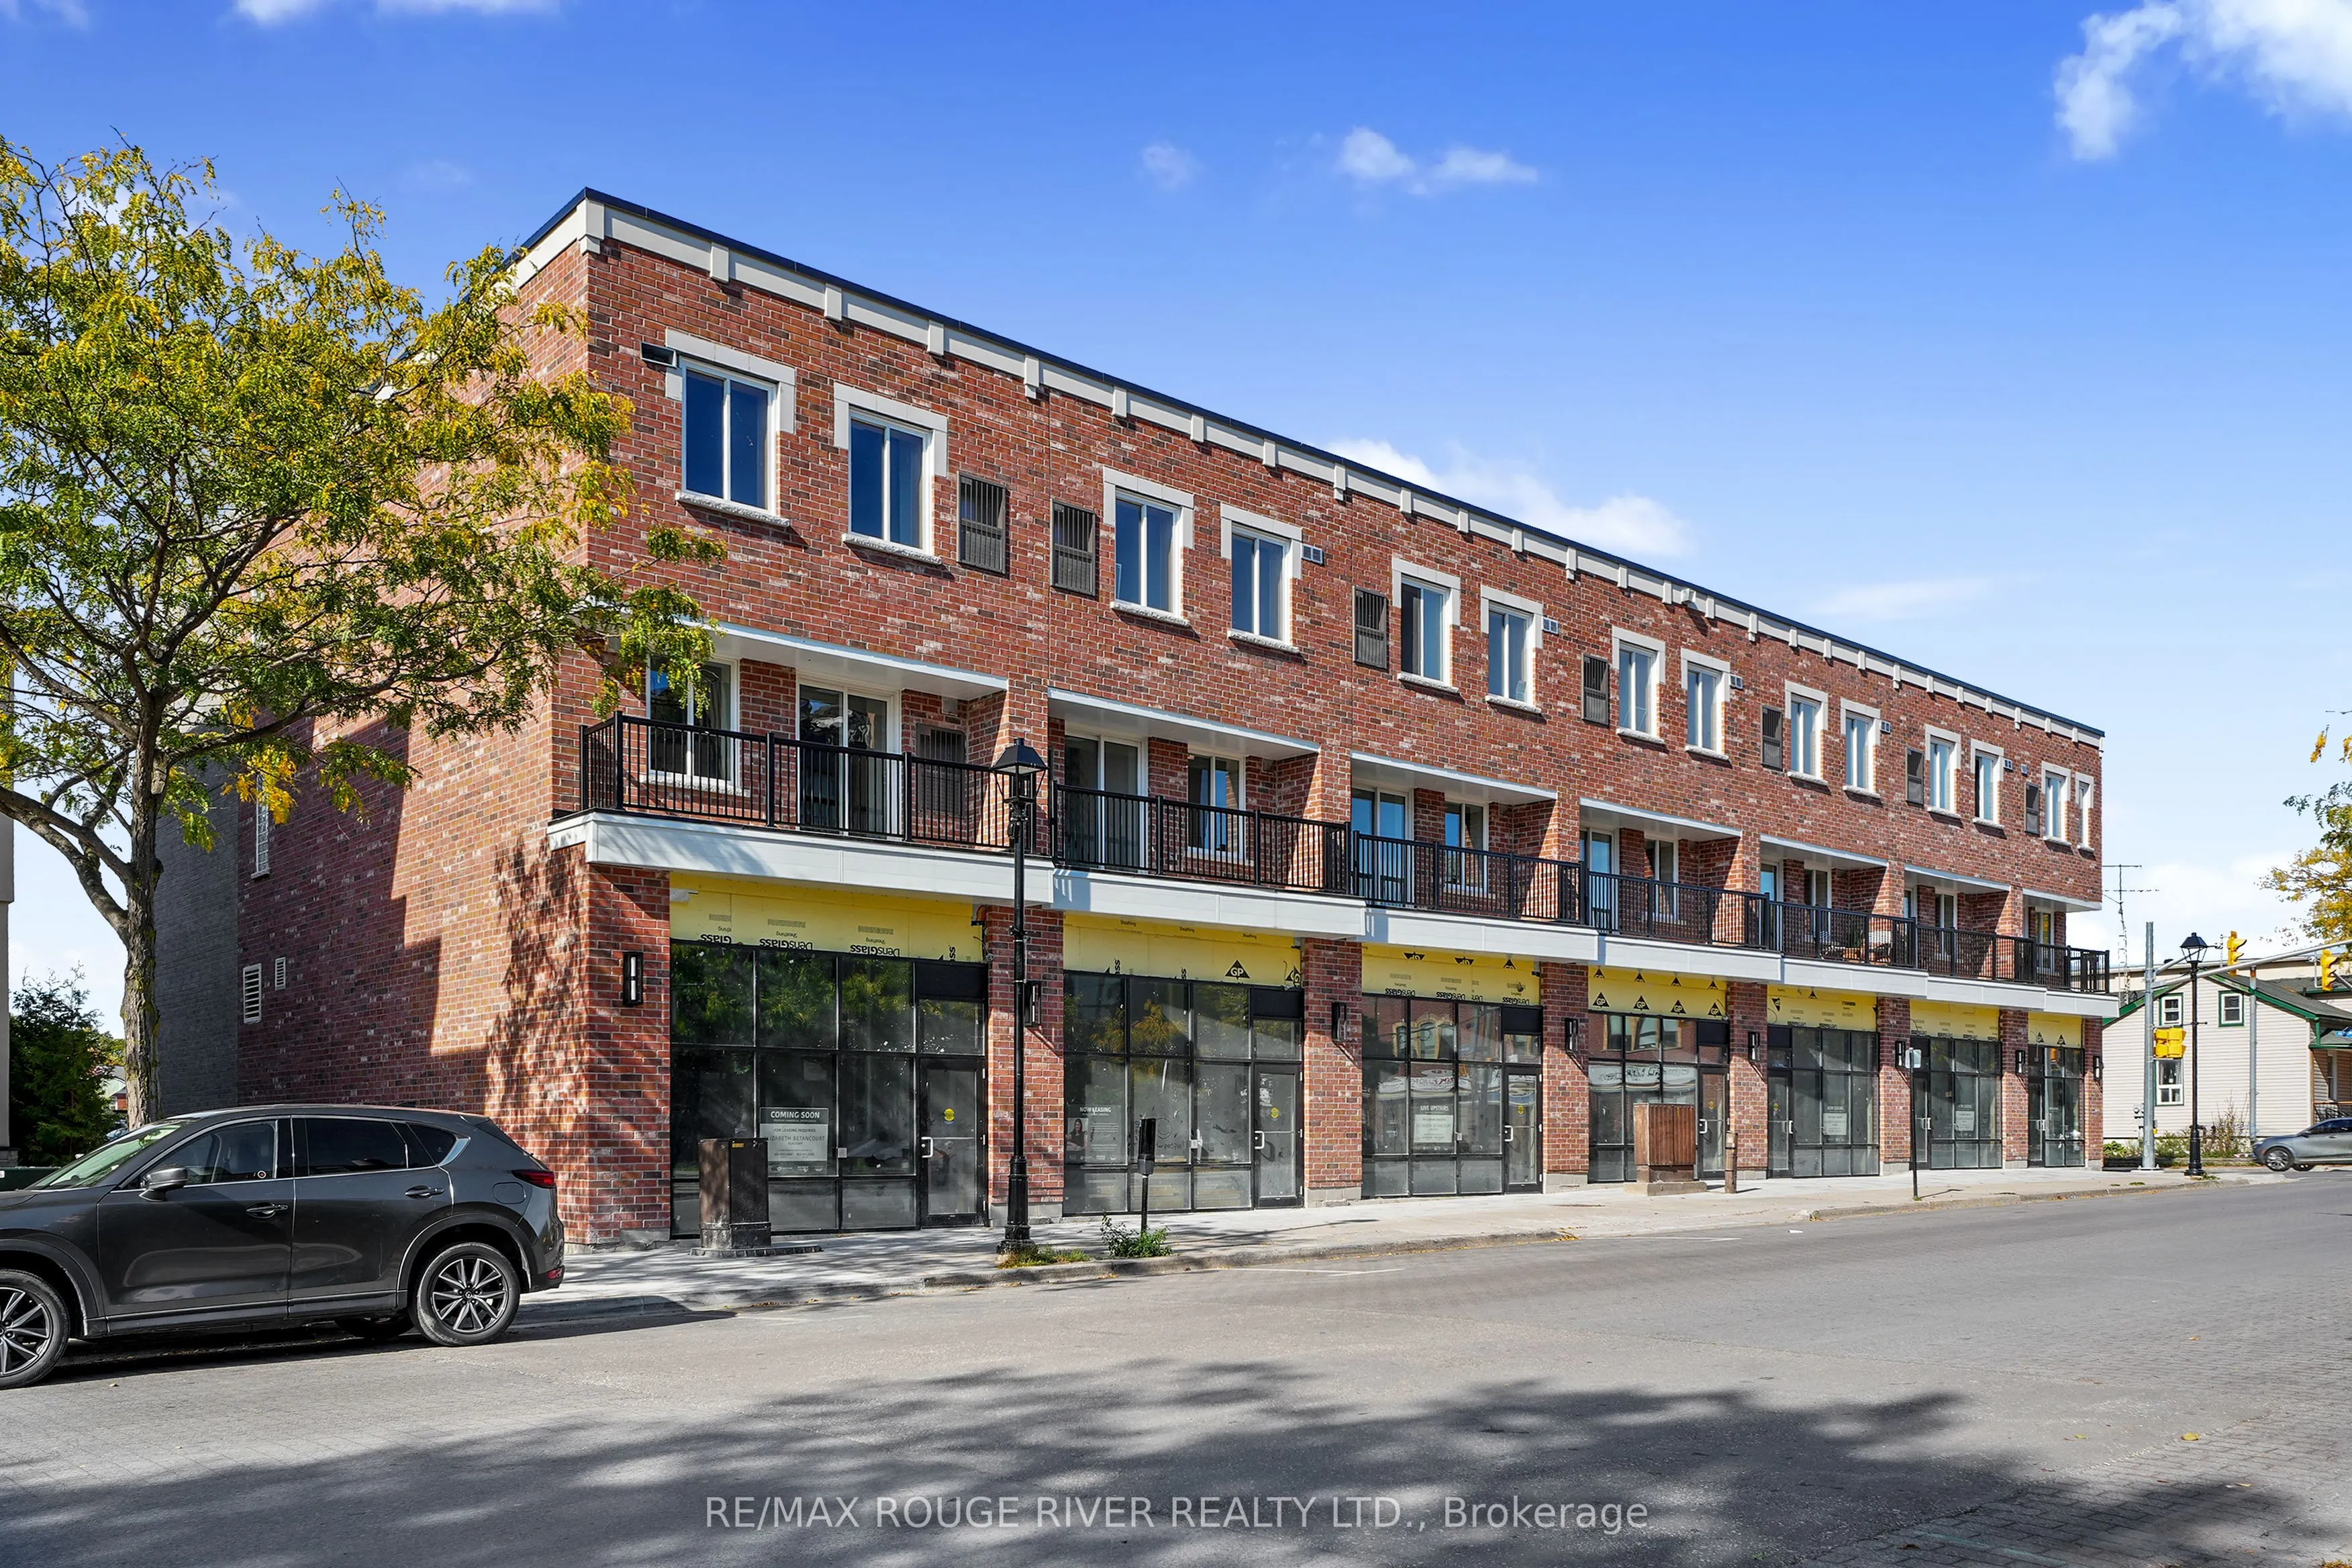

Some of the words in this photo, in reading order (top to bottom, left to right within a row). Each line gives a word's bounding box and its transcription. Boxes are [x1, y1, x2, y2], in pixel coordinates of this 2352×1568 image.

[759, 938, 814, 950] DensGlass
[850, 944, 900, 957] DensGlass
[1230, 967, 1244, 977] GP
